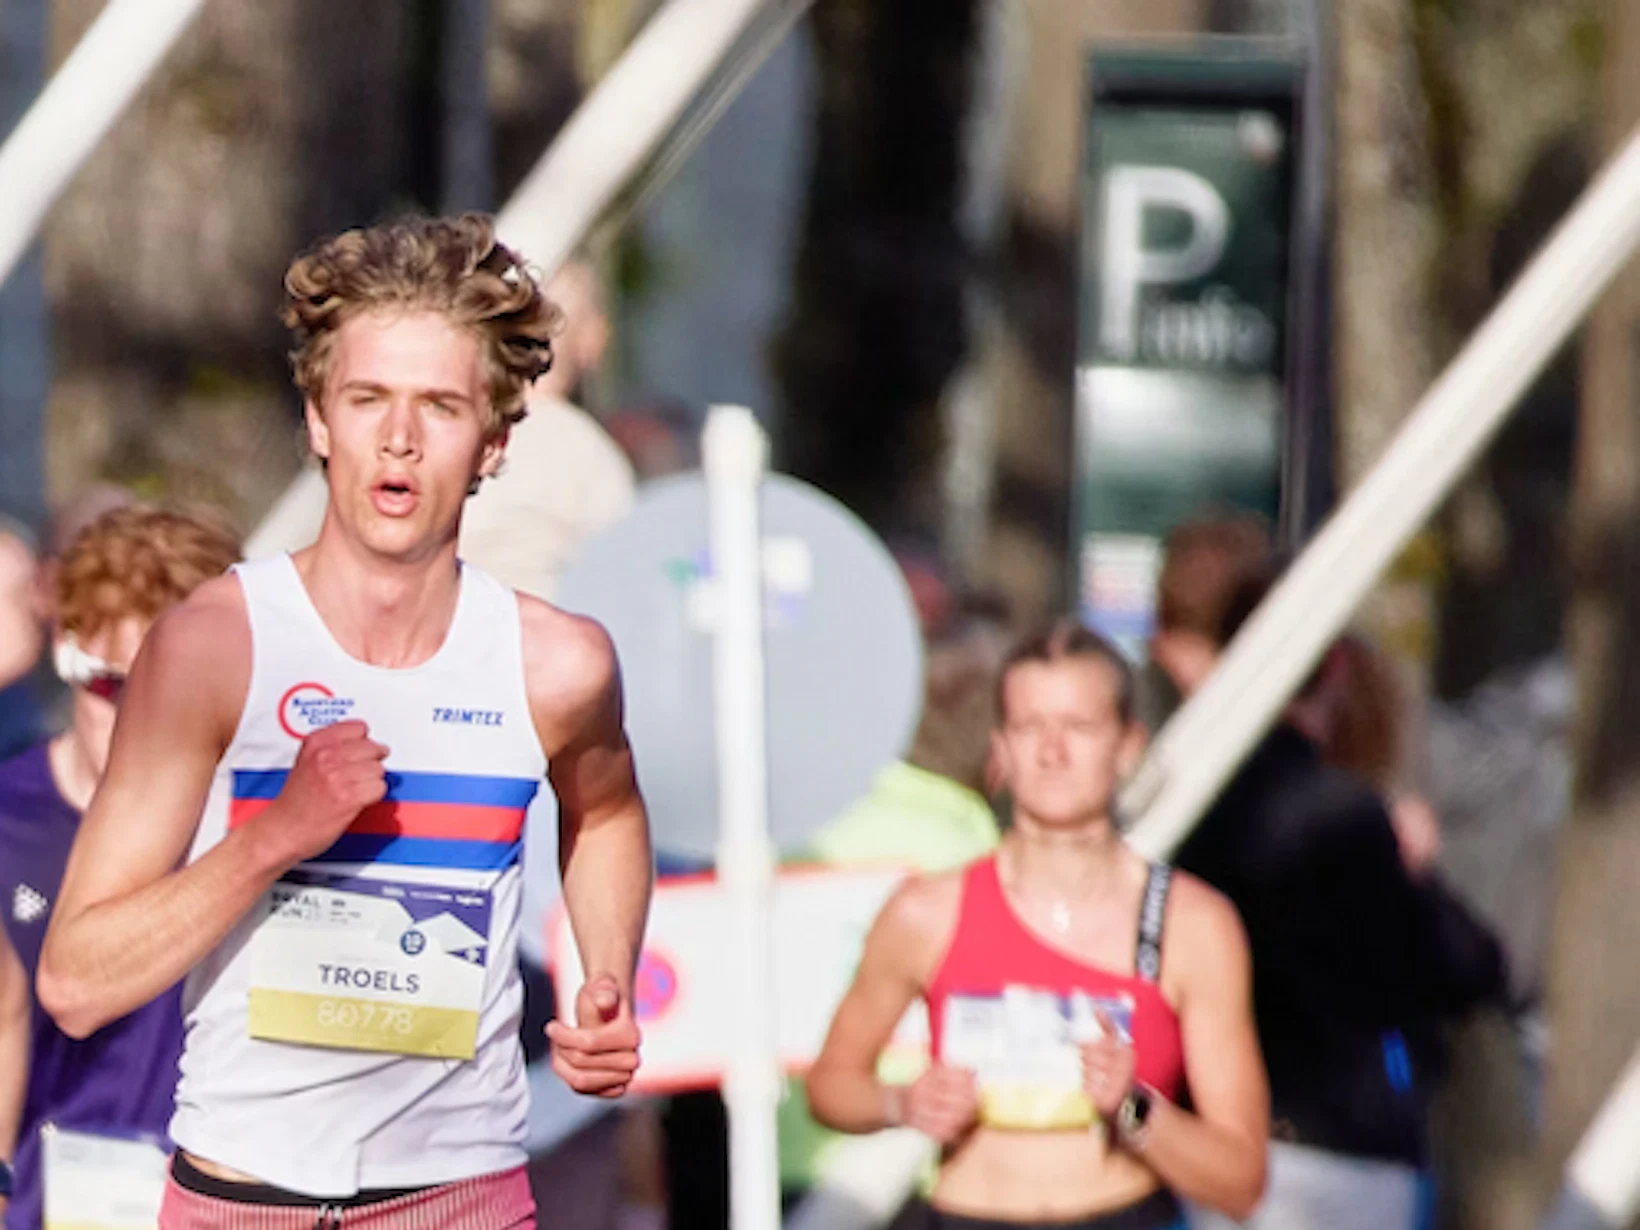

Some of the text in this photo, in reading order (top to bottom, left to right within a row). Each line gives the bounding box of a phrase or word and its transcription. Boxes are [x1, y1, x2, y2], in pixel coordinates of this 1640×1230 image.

[1102, 164, 1230, 358] P
[432, 708, 505, 727] TRIMTEX
[318, 964, 421, 994] TROELS
